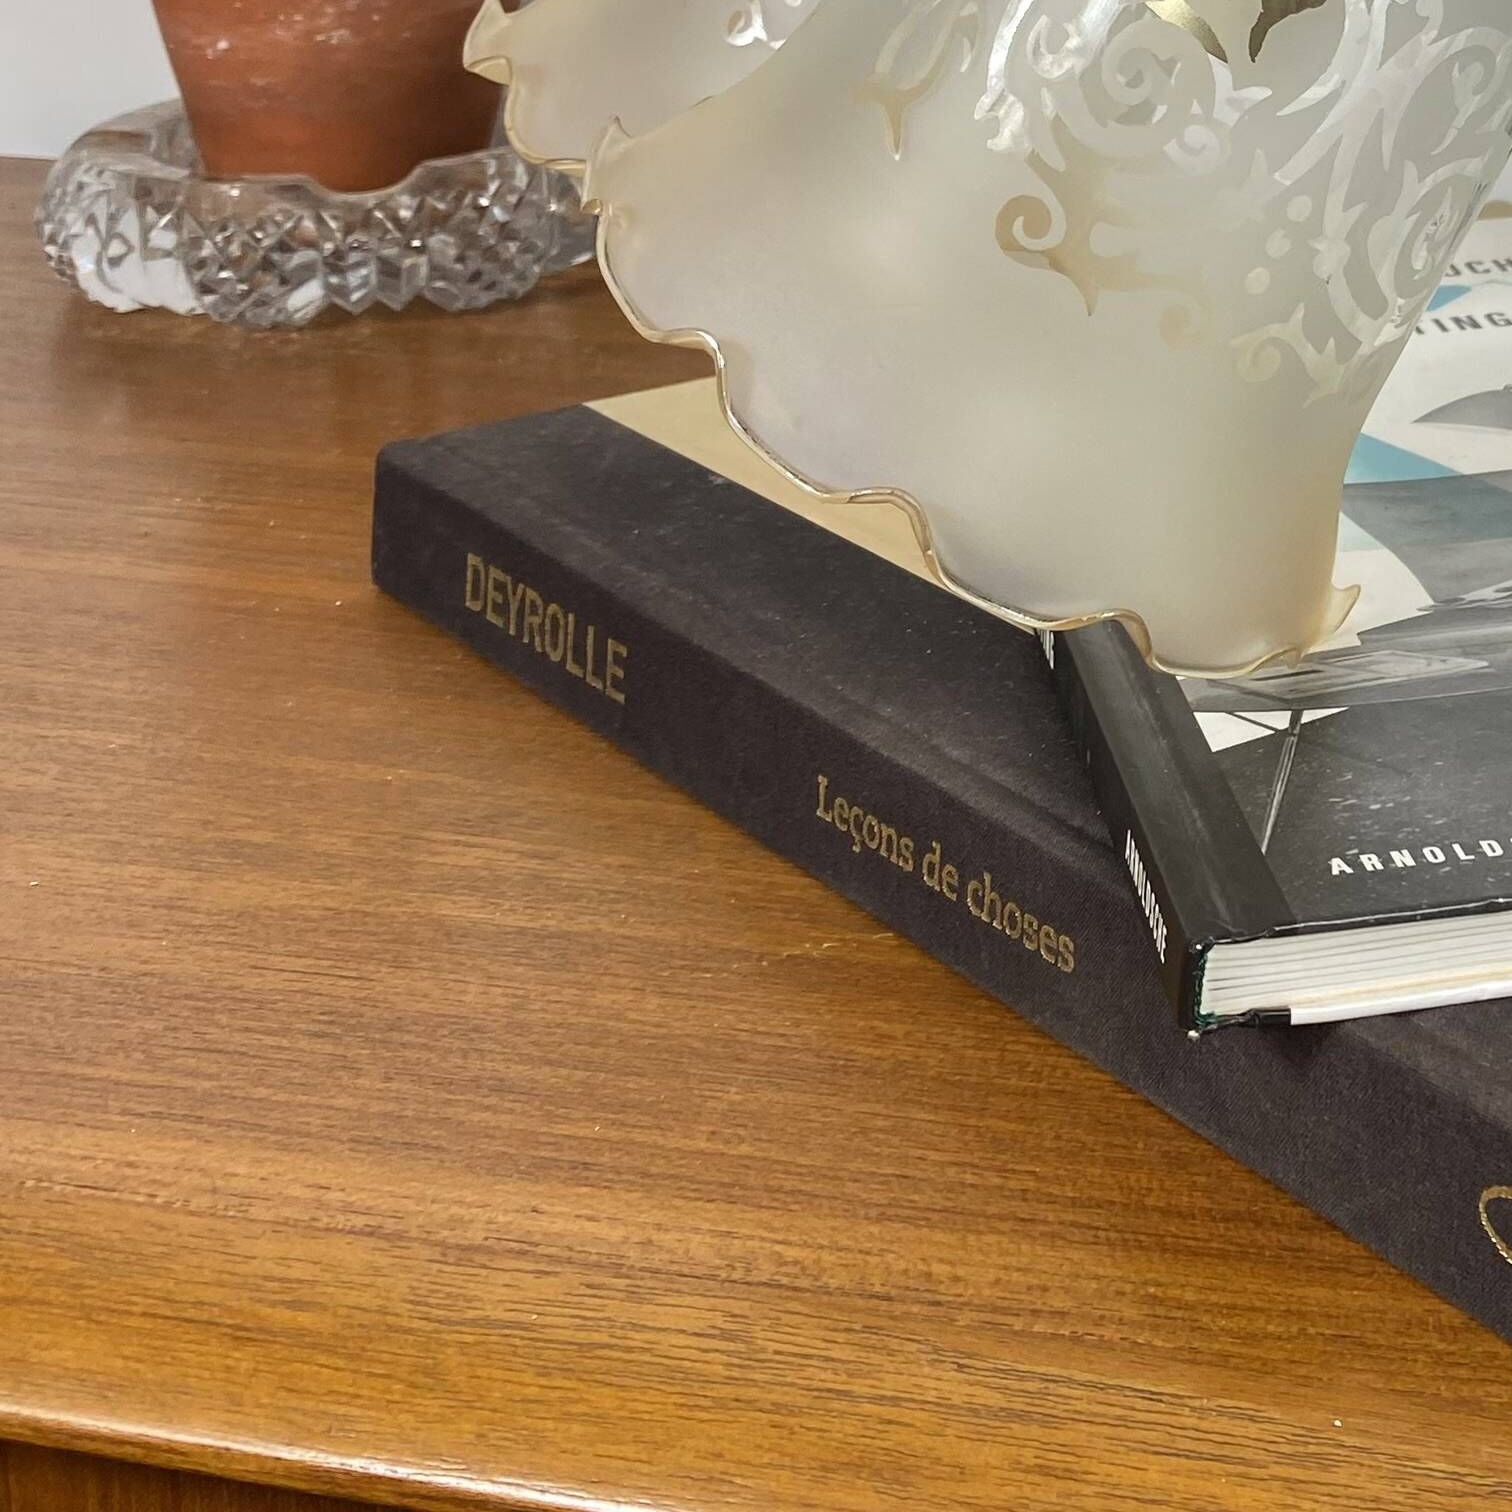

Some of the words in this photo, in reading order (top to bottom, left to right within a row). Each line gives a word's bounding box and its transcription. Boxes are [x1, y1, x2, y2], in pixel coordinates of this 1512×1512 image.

[464, 552, 627, 705] DEYROLLE
[816, 775, 914, 874] Leçons
[921, 841, 958, 902] de
[965, 872, 1075, 974] choses
